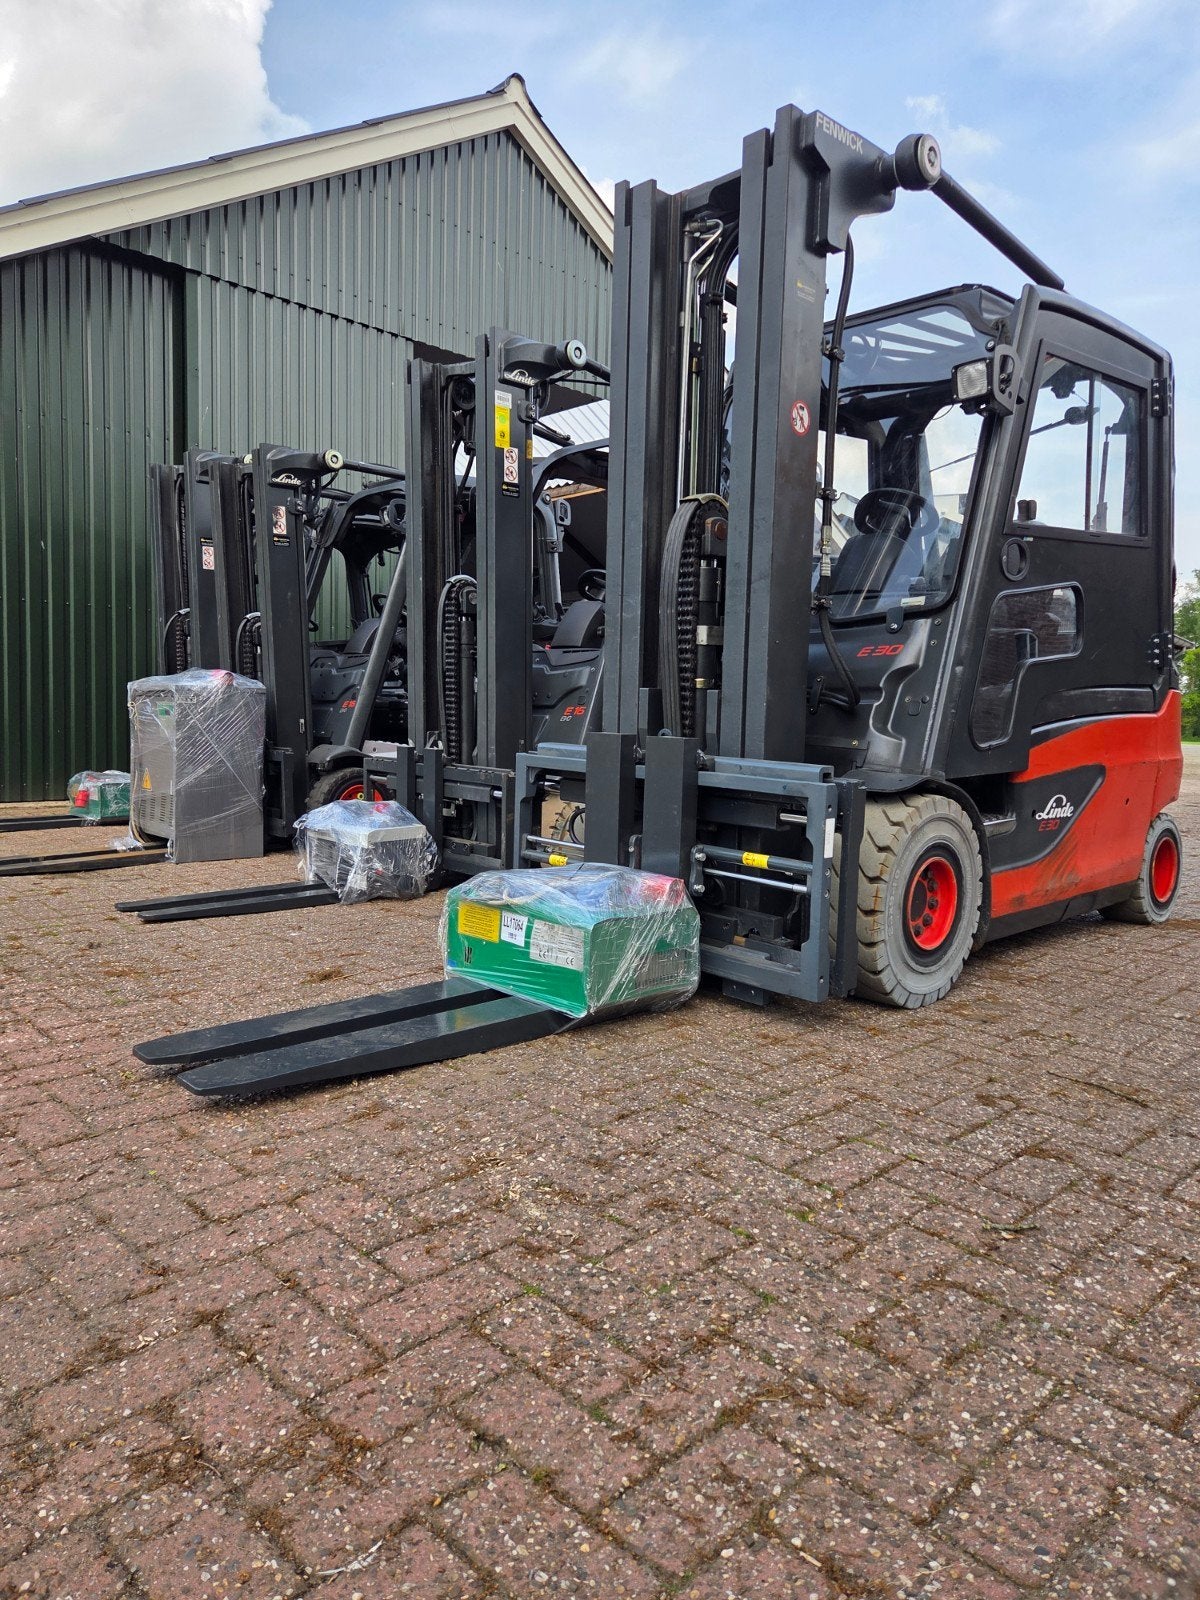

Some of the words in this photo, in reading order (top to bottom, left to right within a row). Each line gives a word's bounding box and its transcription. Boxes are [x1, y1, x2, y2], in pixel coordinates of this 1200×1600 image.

[816, 112, 863, 155] FENWICK
[504, 369, 536, 385] Linde
[272, 473, 302, 486] Linde
[1035, 794, 1074, 820] Linde
[503, 915, 524, 931] LL17064
